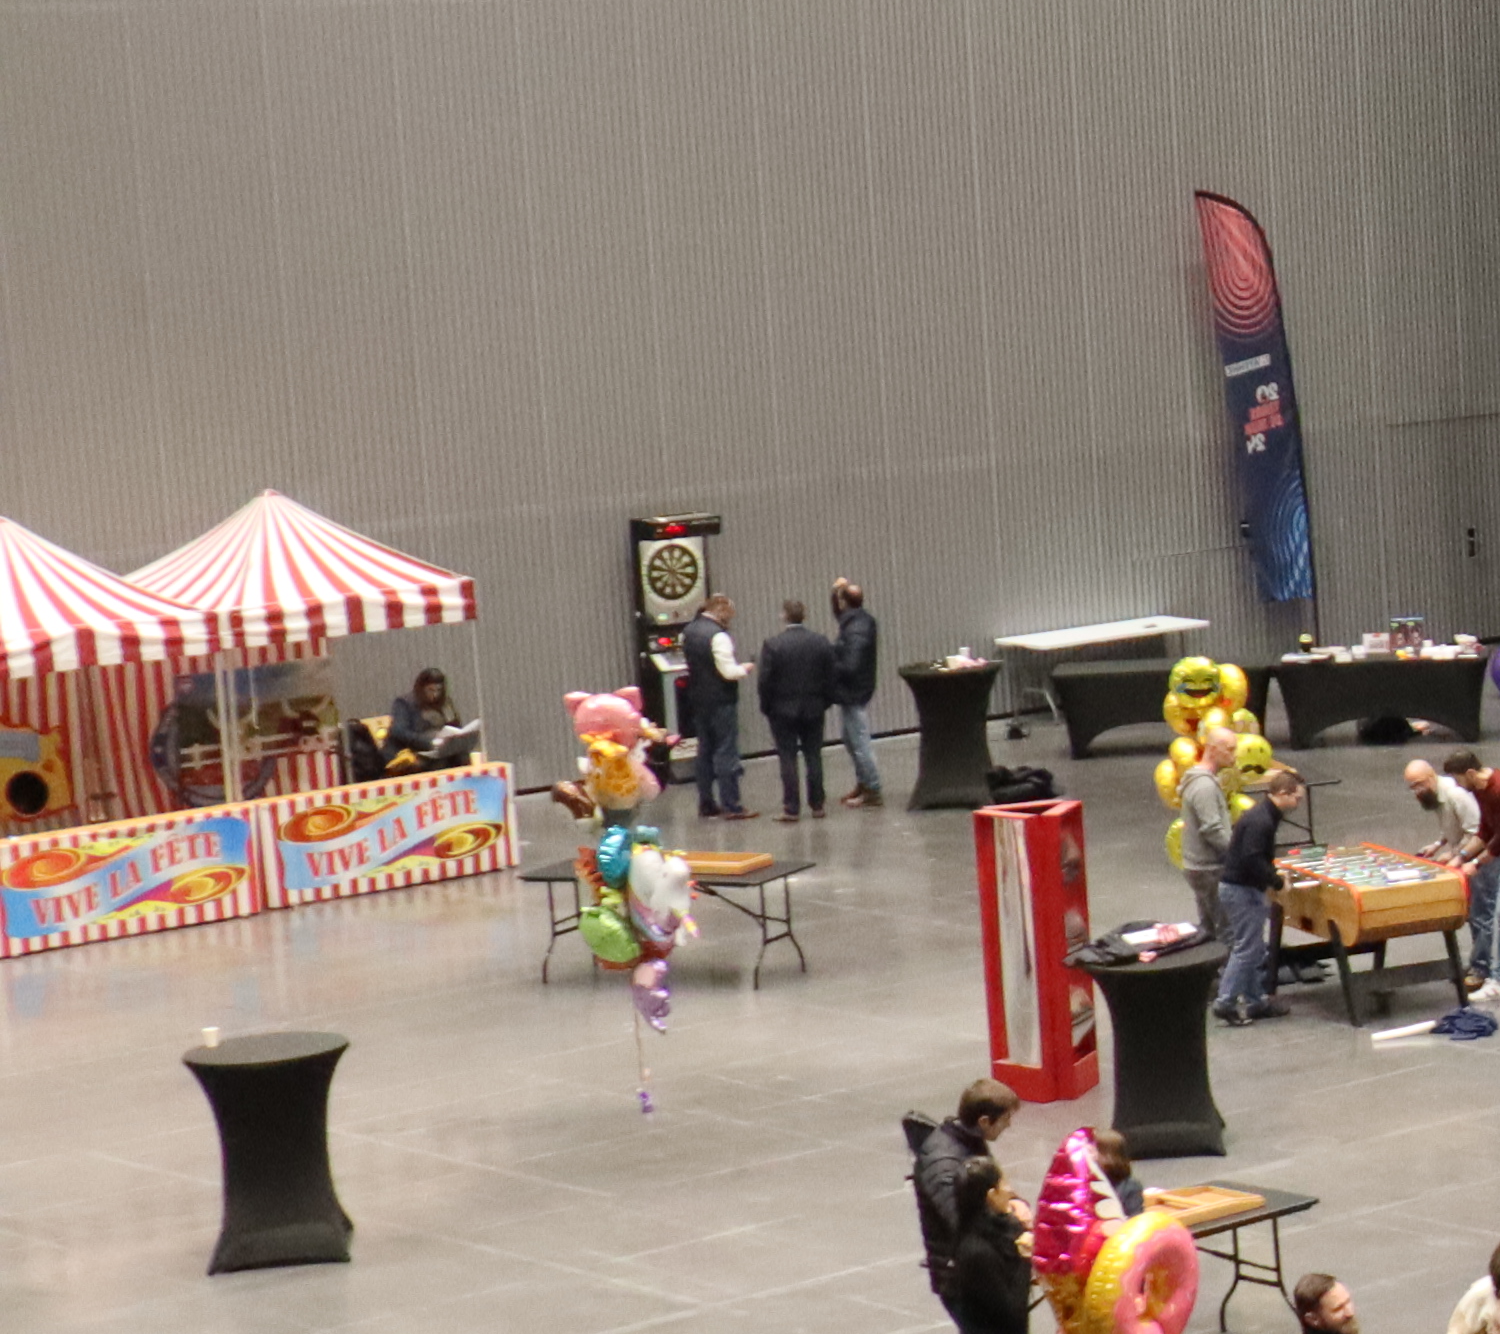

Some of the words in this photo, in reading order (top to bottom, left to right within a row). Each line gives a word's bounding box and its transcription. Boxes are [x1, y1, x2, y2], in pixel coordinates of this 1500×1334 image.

[31, 883, 98, 927] VIVE
[107, 860, 142, 899] LA
[150, 830, 222, 874] FÊTE
[305, 839, 371, 878] VIVE
[377, 817, 407, 854] LA
[414, 789, 478, 830] FÊTE
